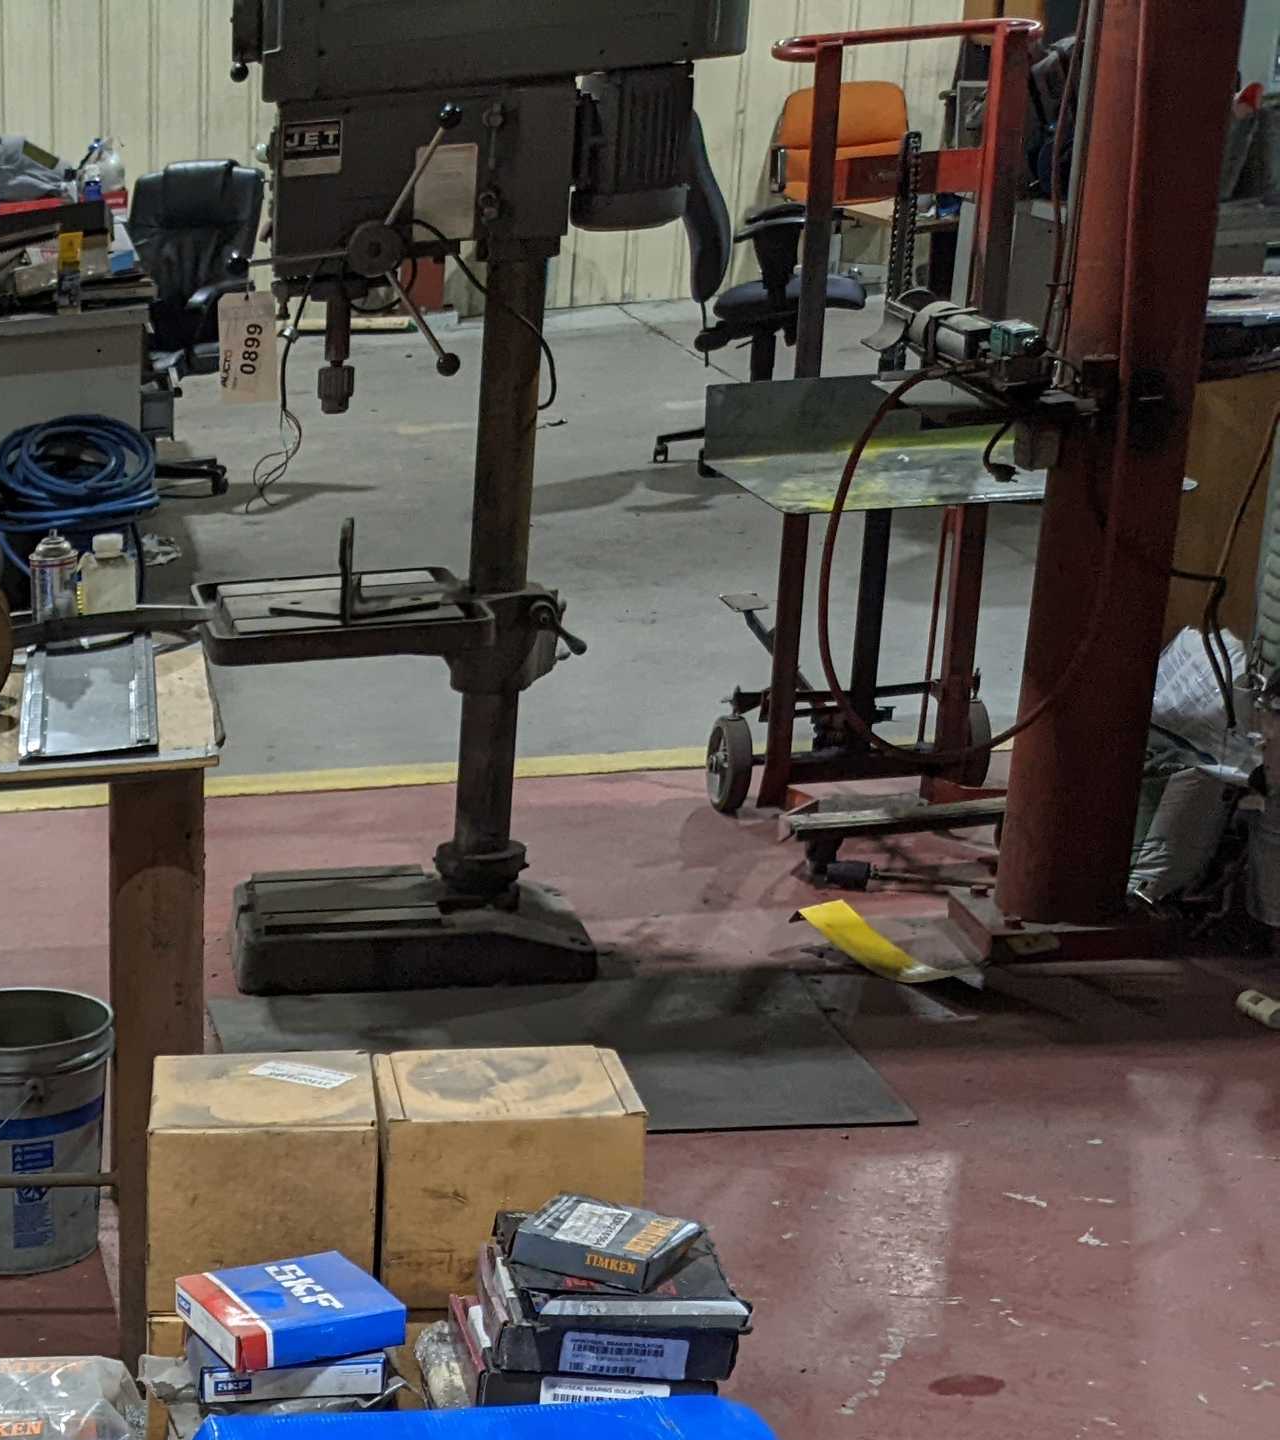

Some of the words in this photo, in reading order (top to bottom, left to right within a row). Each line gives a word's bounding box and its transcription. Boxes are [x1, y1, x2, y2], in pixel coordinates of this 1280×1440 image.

[286, 131, 339, 148] JET
[240, 323, 263, 376] 0899
[585, 1252, 637, 1276] TIMKEN
[265, 1264, 344, 1312] SKF
